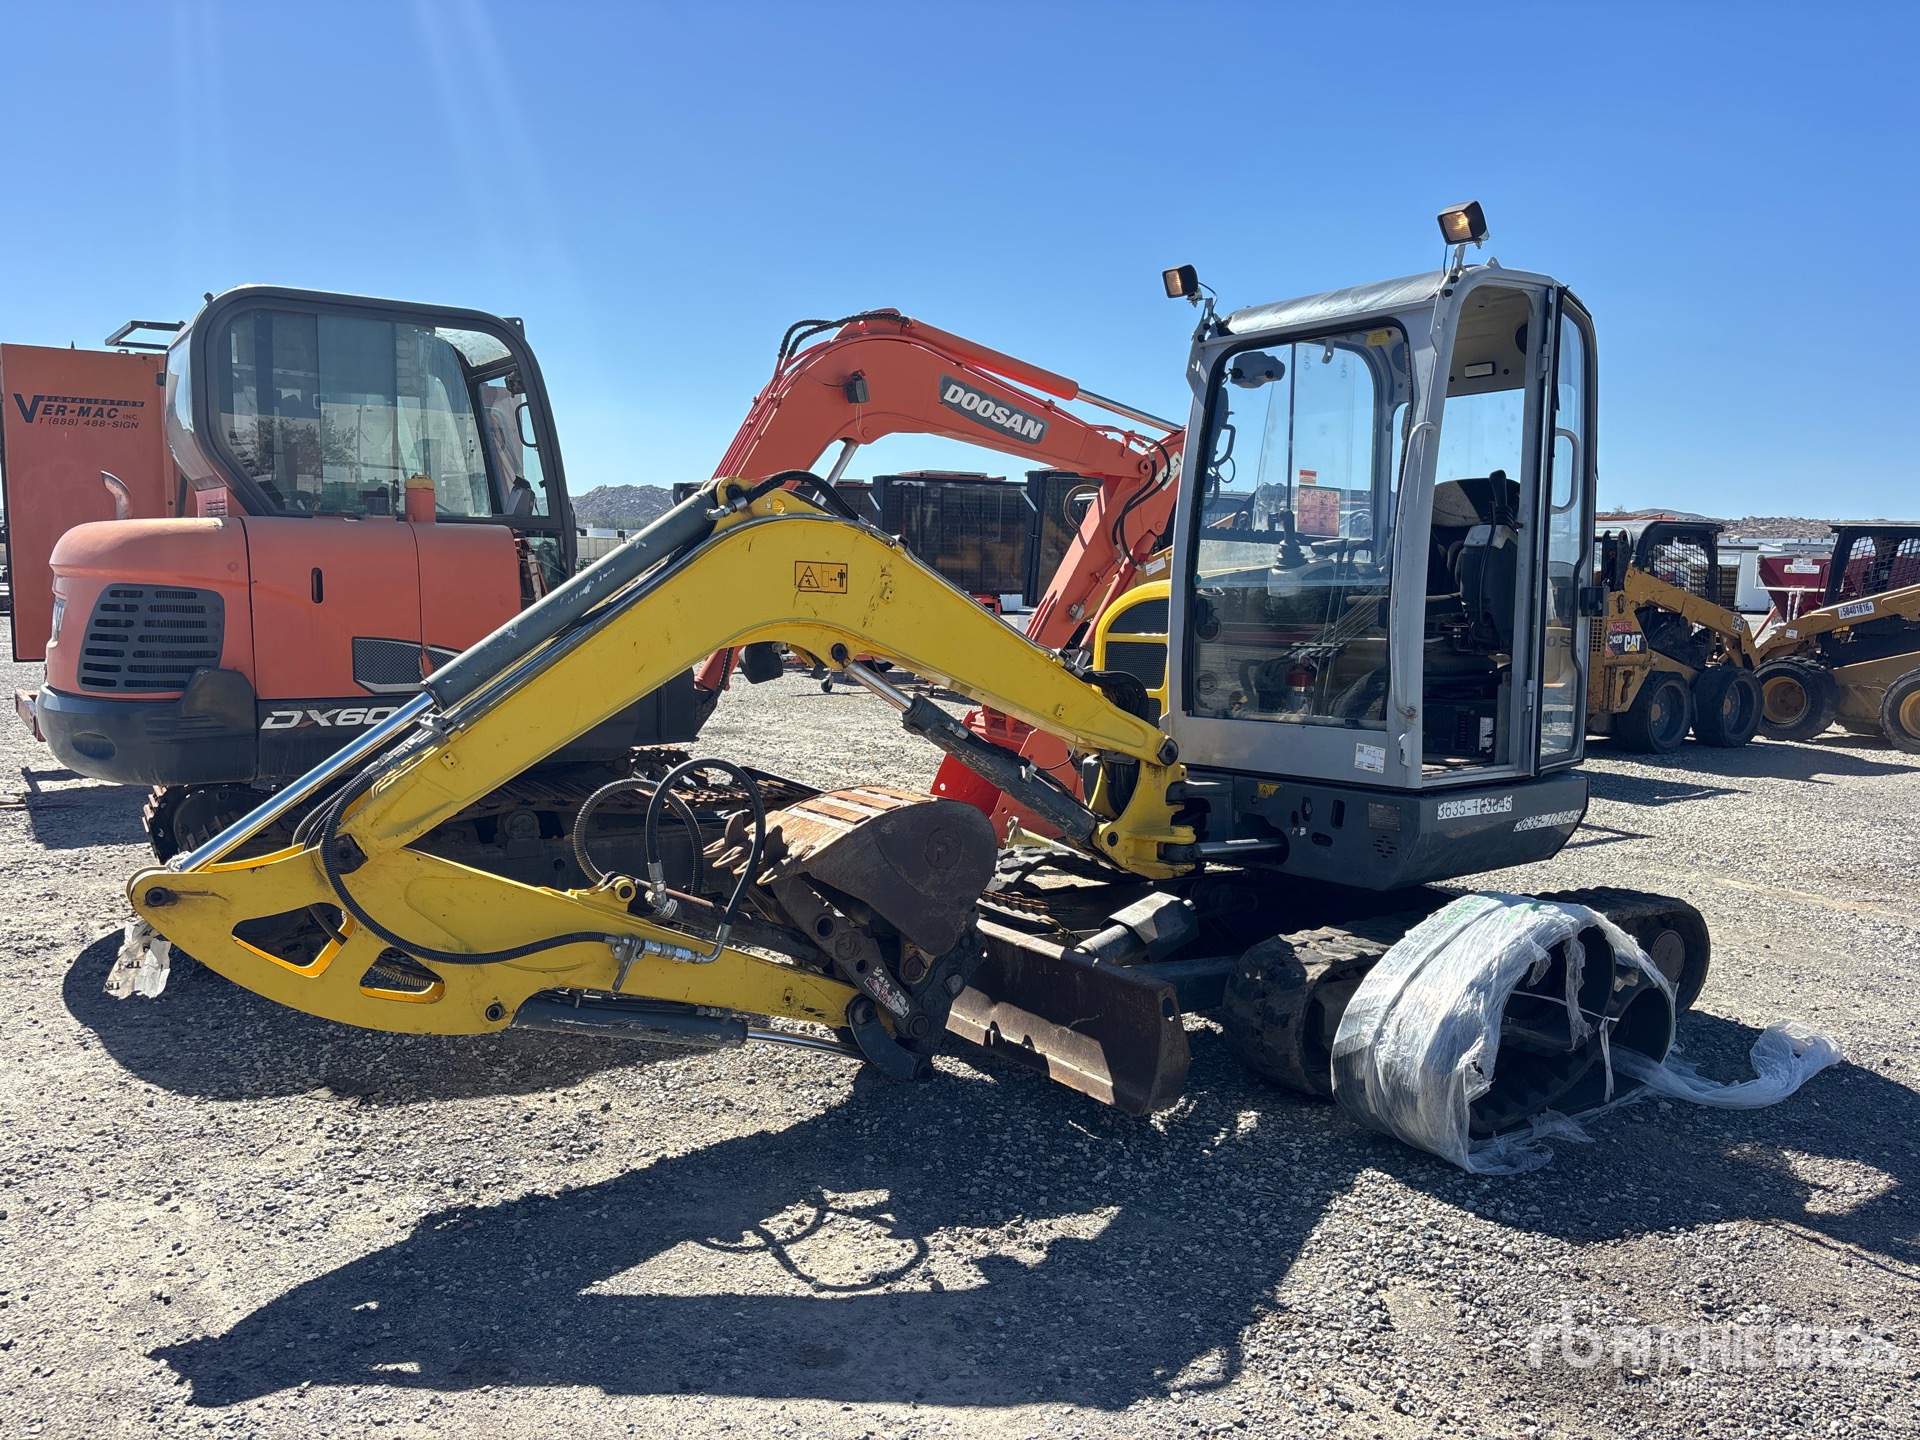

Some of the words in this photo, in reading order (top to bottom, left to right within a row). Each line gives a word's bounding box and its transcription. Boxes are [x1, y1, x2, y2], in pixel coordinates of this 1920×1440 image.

[13, 393, 119, 424] VER-MAC
[42, 396, 143, 407] SIGNALISATION
[943, 384, 1043, 440] DOOSAN
[48, 417, 79, 426] (888)
[83, 419, 139, 429] 488-SIGN
[1624, 634, 1642, 652] CAT
[261, 706, 400, 730] DX60
